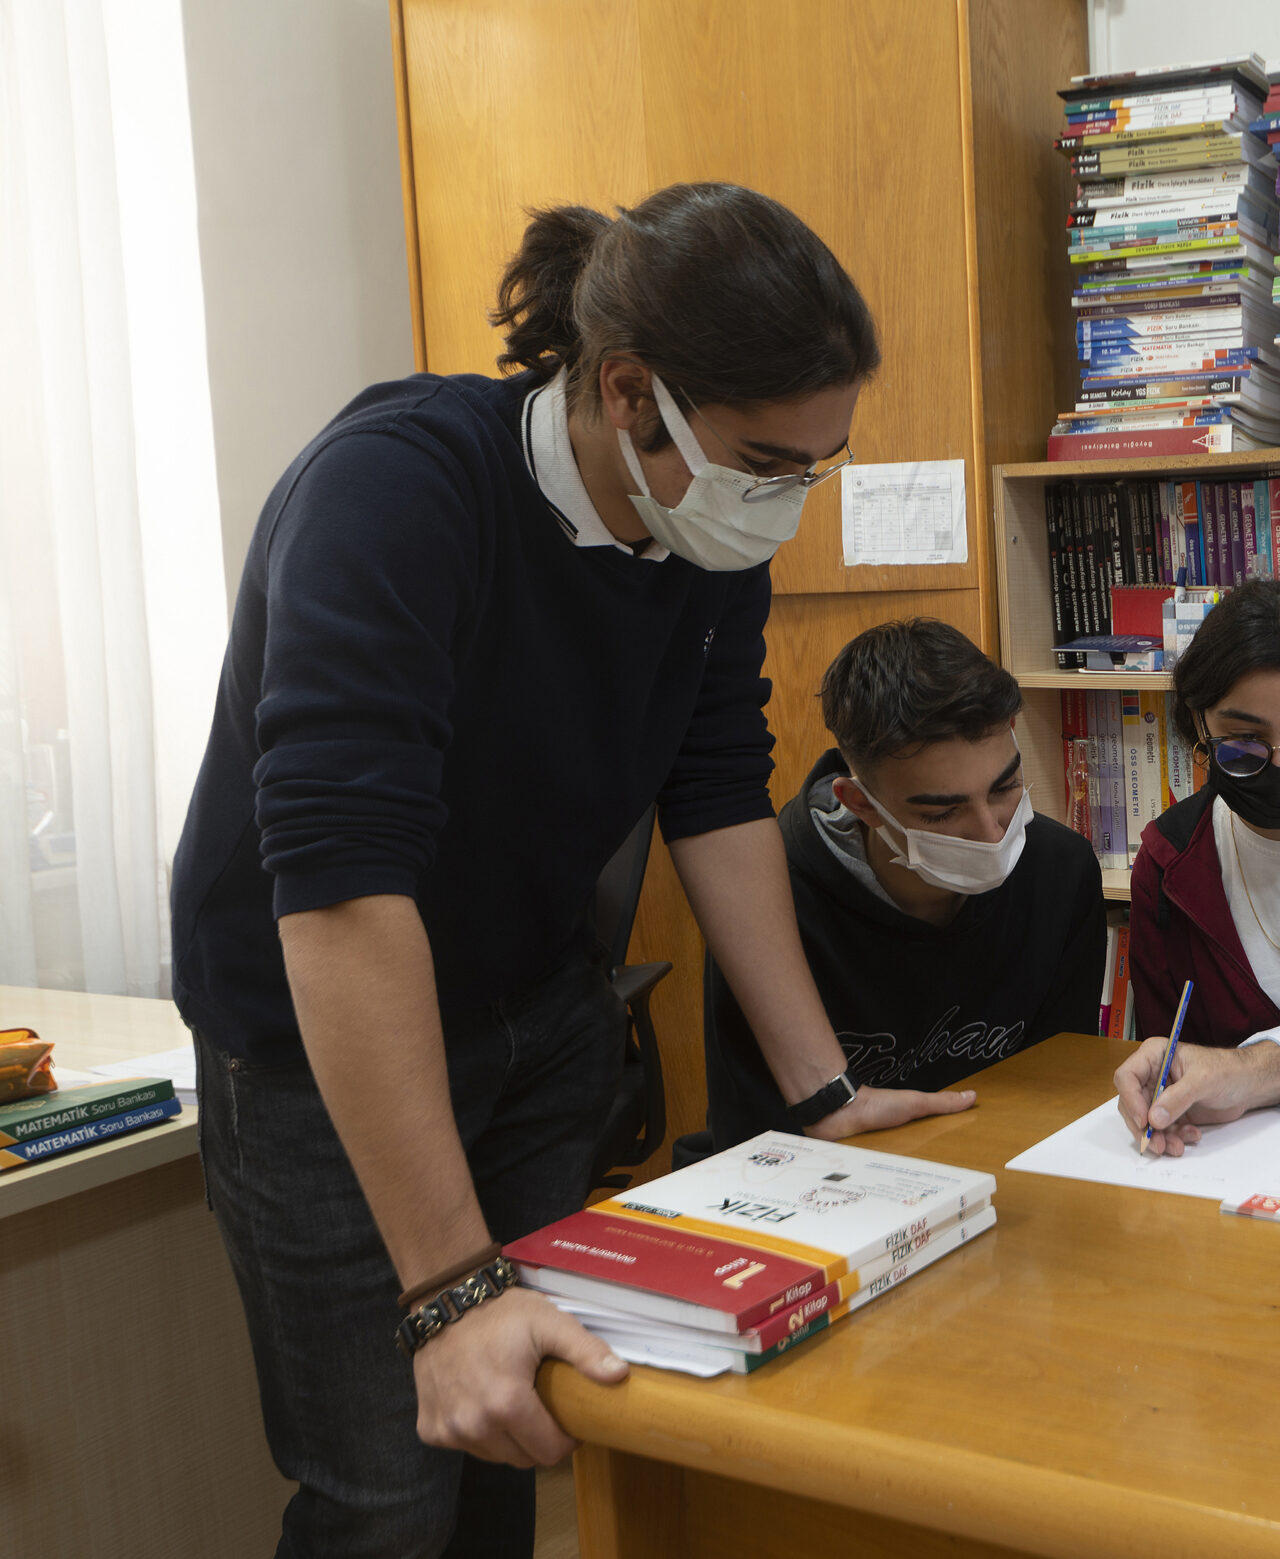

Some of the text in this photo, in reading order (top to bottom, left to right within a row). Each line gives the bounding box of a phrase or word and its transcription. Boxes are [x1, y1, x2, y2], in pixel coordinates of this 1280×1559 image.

[1132, 180, 1154, 190] Fizik
[1146, 733, 1155, 764] Geometri
[16, 1089, 156, 1137] MATEMATİK Soru Bankası
[25, 1108, 163, 1158] MATEMATİK Soru Bankası
[705, 1198, 798, 1222] FİZİK
[786, 1281, 812, 1303] Kitap
[886, 1229, 908, 1248] FİZİK
[910, 1217, 928, 1235] DAF
[788, 1230, 931, 1330] 2 Kitap FİZİK DAF
[870, 1276, 892, 1295] FİZİK
[894, 1265, 908, 1281] DAF
